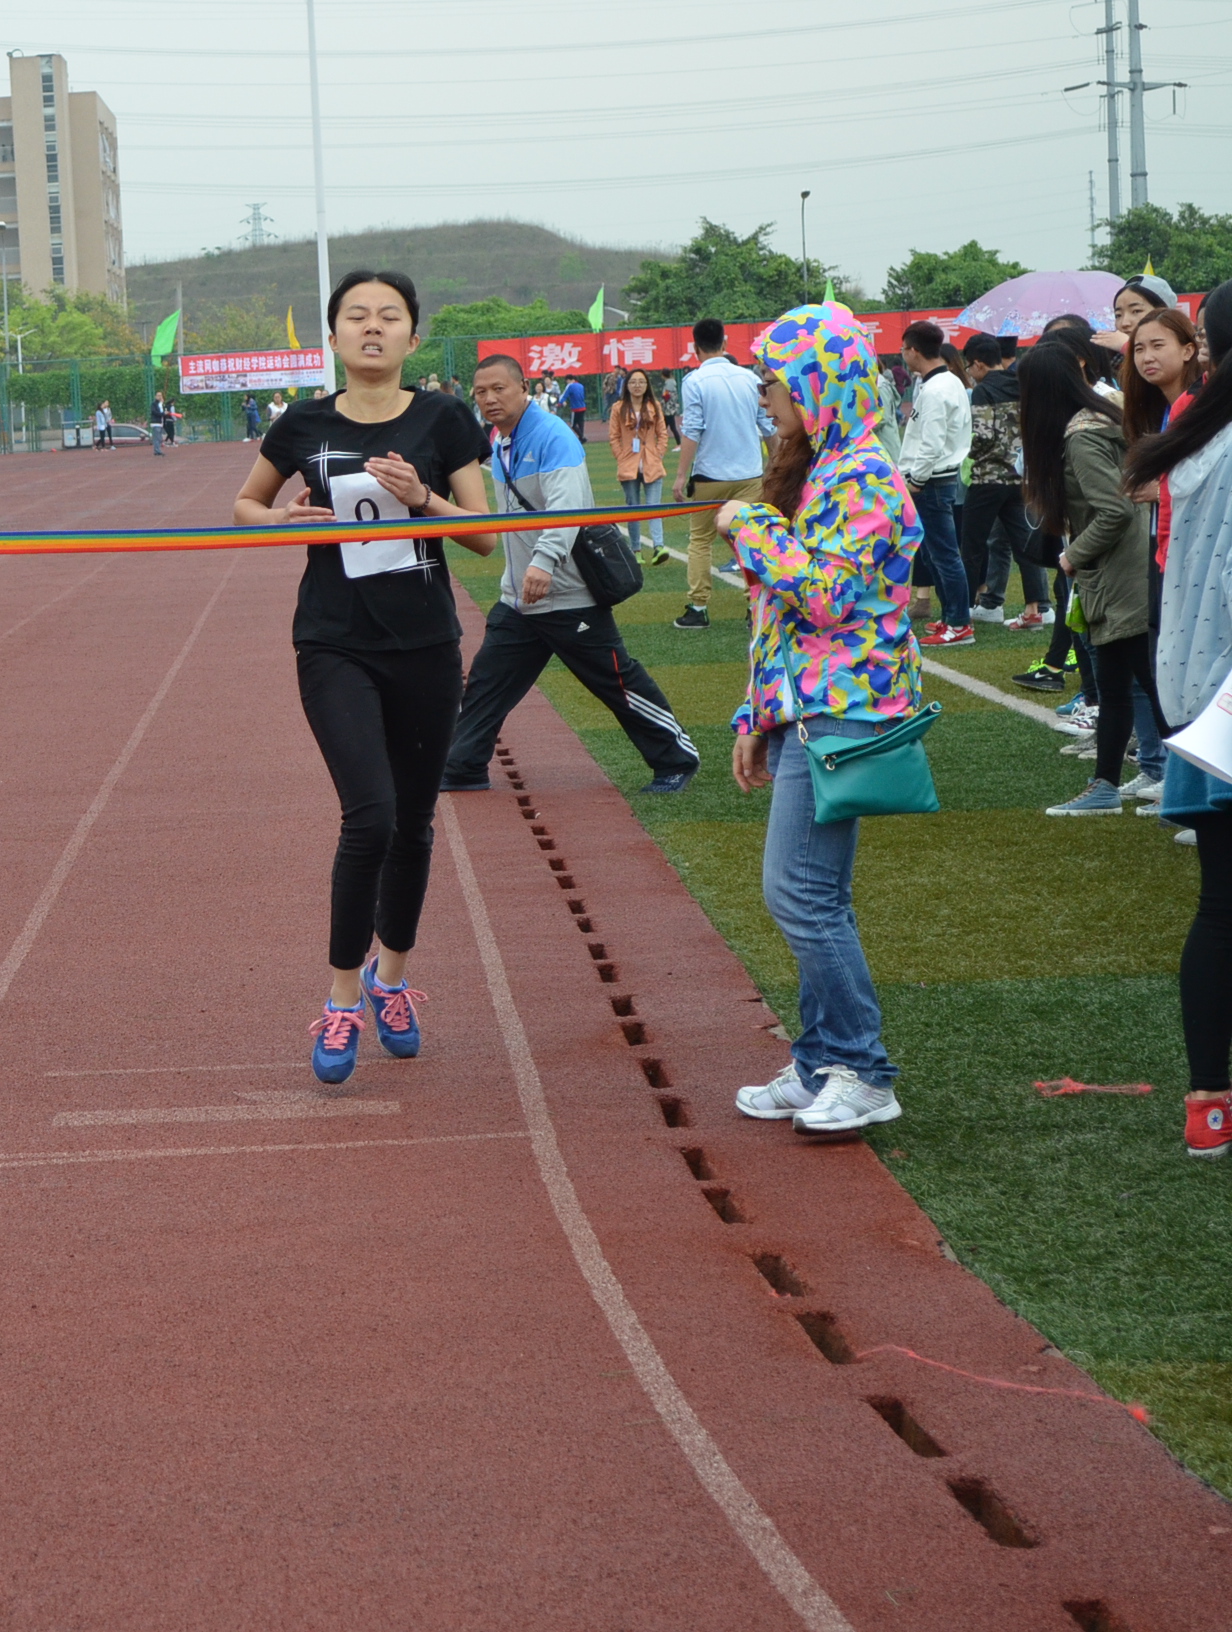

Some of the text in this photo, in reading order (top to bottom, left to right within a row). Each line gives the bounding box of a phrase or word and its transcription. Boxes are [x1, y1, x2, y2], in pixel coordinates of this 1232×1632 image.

[188, 353, 324, 374] 主流网咖恭祝财经学院运动会圆满成功
